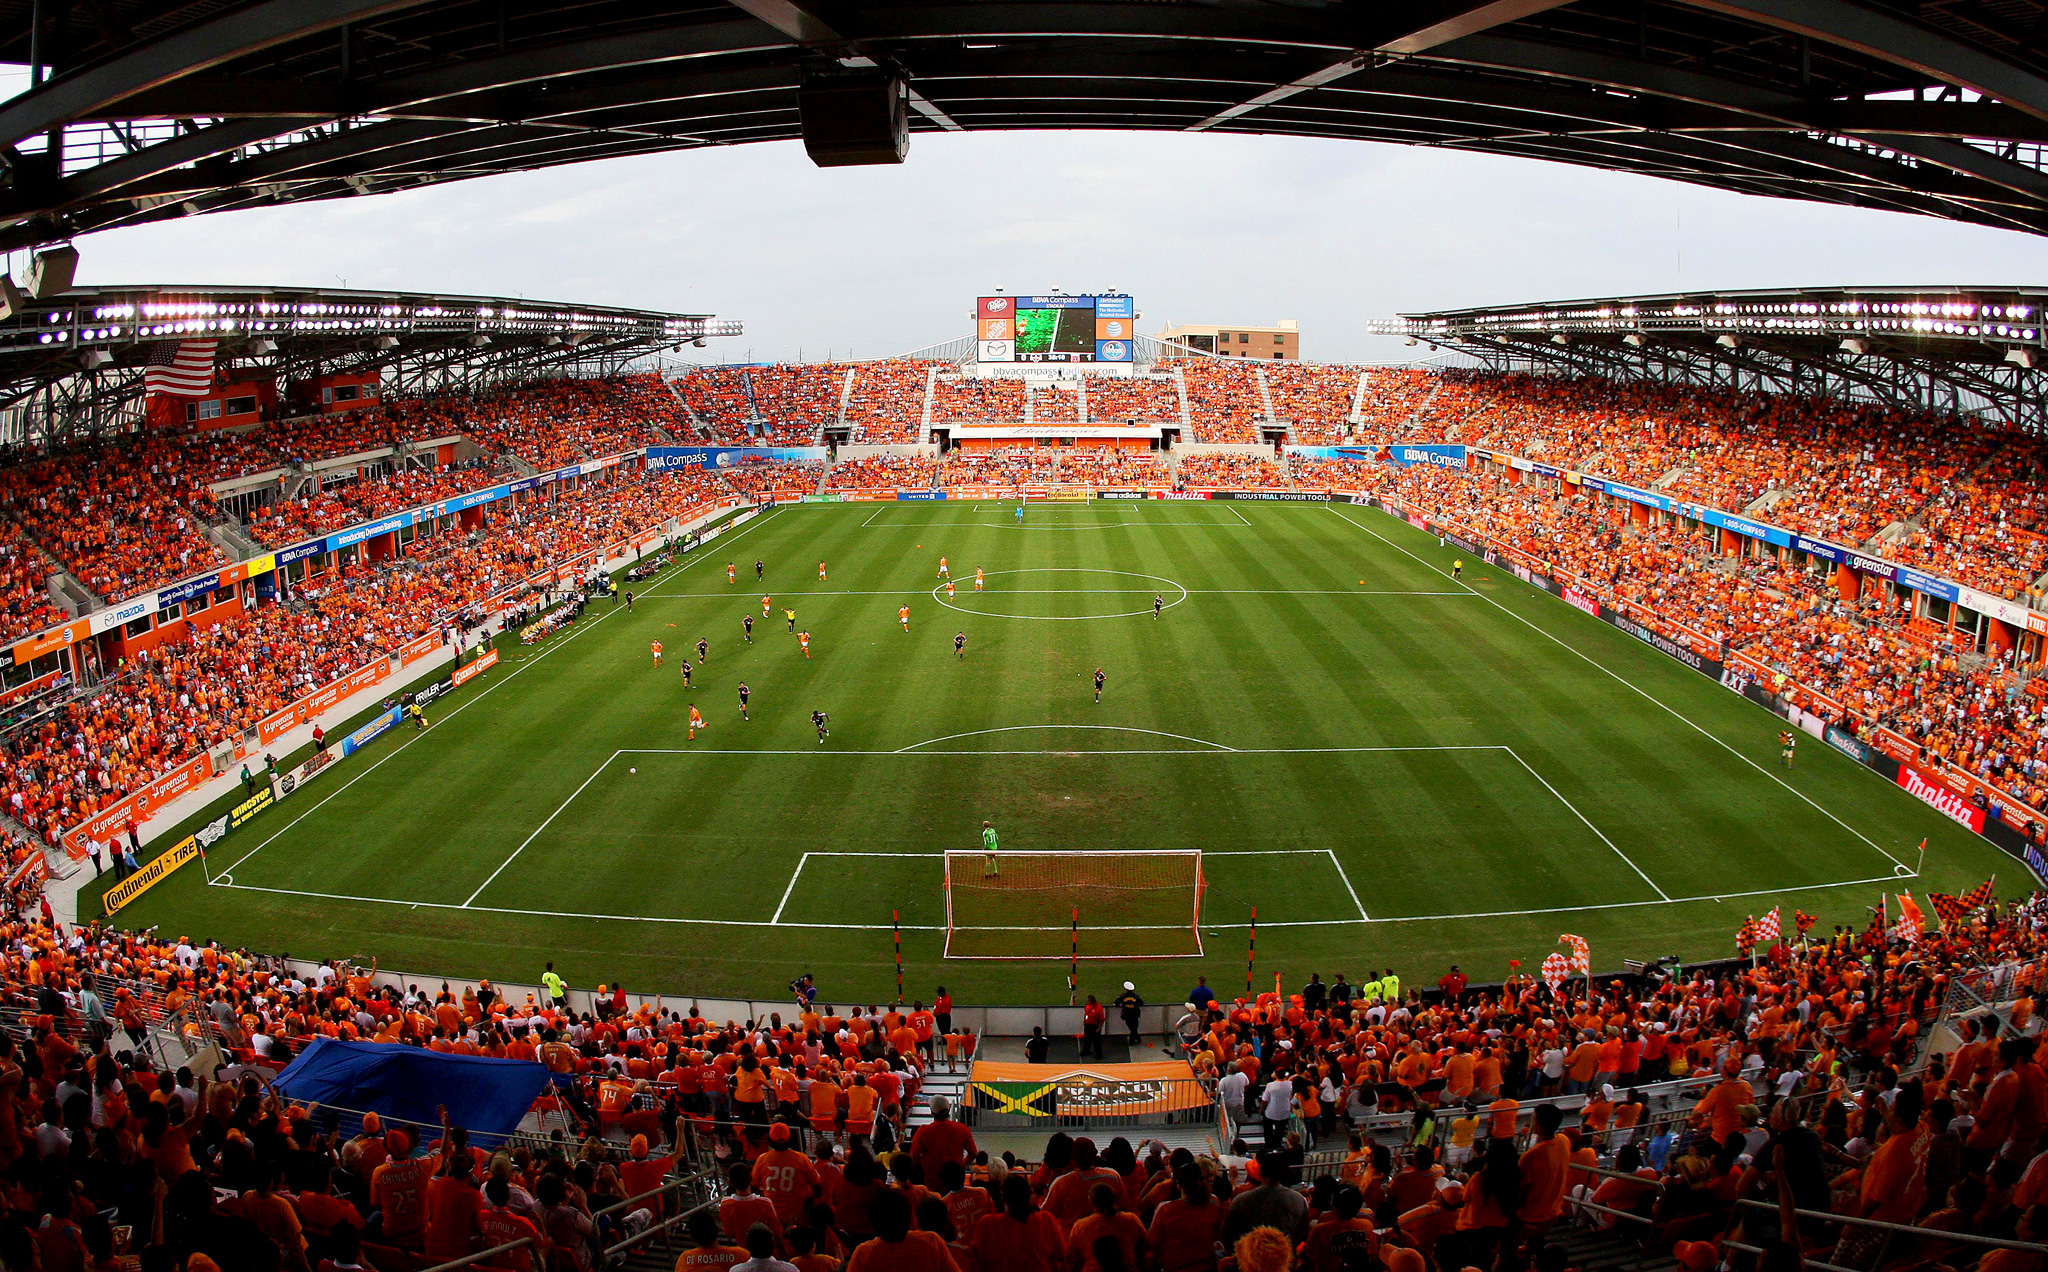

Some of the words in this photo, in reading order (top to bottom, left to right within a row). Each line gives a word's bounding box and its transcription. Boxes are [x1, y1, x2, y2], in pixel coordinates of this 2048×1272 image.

[1050, 297, 1079, 305] Compass
[647, 456, 666, 470] BBVA
[666, 452, 708, 467] Compass
[1404, 448, 1430, 464] BBVA
[1430, 451, 1465, 470] Compass
[1118, 491, 1142, 499] adidas
[1234, 492, 1279, 500] INDUSTRIAL
[338, 531, 366, 545] Introducing
[365, 523, 385, 537] Dynamo
[1722, 517, 1766, 538] 1-800-COMPASS
[295, 545, 319, 558] Compass
[1811, 543, 1836, 559] Compass
[1853, 554, 1895, 577] greenstar
[116, 604, 145, 622] mazda
[2028, 616, 2046, 633] THE
[1614, 615, 1652, 643] INDUSTRIAL
[1651, 635, 1677, 656] POWER
[1676, 649, 1701, 669] TOOLS
[355, 667, 376, 687] greenstar
[314, 687, 337, 708] greenstar
[269, 711, 294, 732] greenstar
[1829, 730, 1861, 761] Makita
[1886, 736, 1914, 756] reenstar
[159, 770, 189, 797] greenstar
[171, 780, 190, 794] RECYCLING
[231, 787, 271, 819] WINGSTOP
[1904, 768, 1973, 830] Makita
[100, 804, 132, 832] greenstar
[106, 859, 164, 912] Continental
[173, 841, 195, 864] TIRE
[776, 1078, 783, 1090] 4
[602, 1089, 617, 1104] 14
[381, 1170, 407, 1186] CHING
[765, 1165, 796, 1193] 28
[391, 1187, 419, 1215] 25
[686, 1254, 697, 1264] DE
[697, 1253, 735, 1265] ROSARIO
